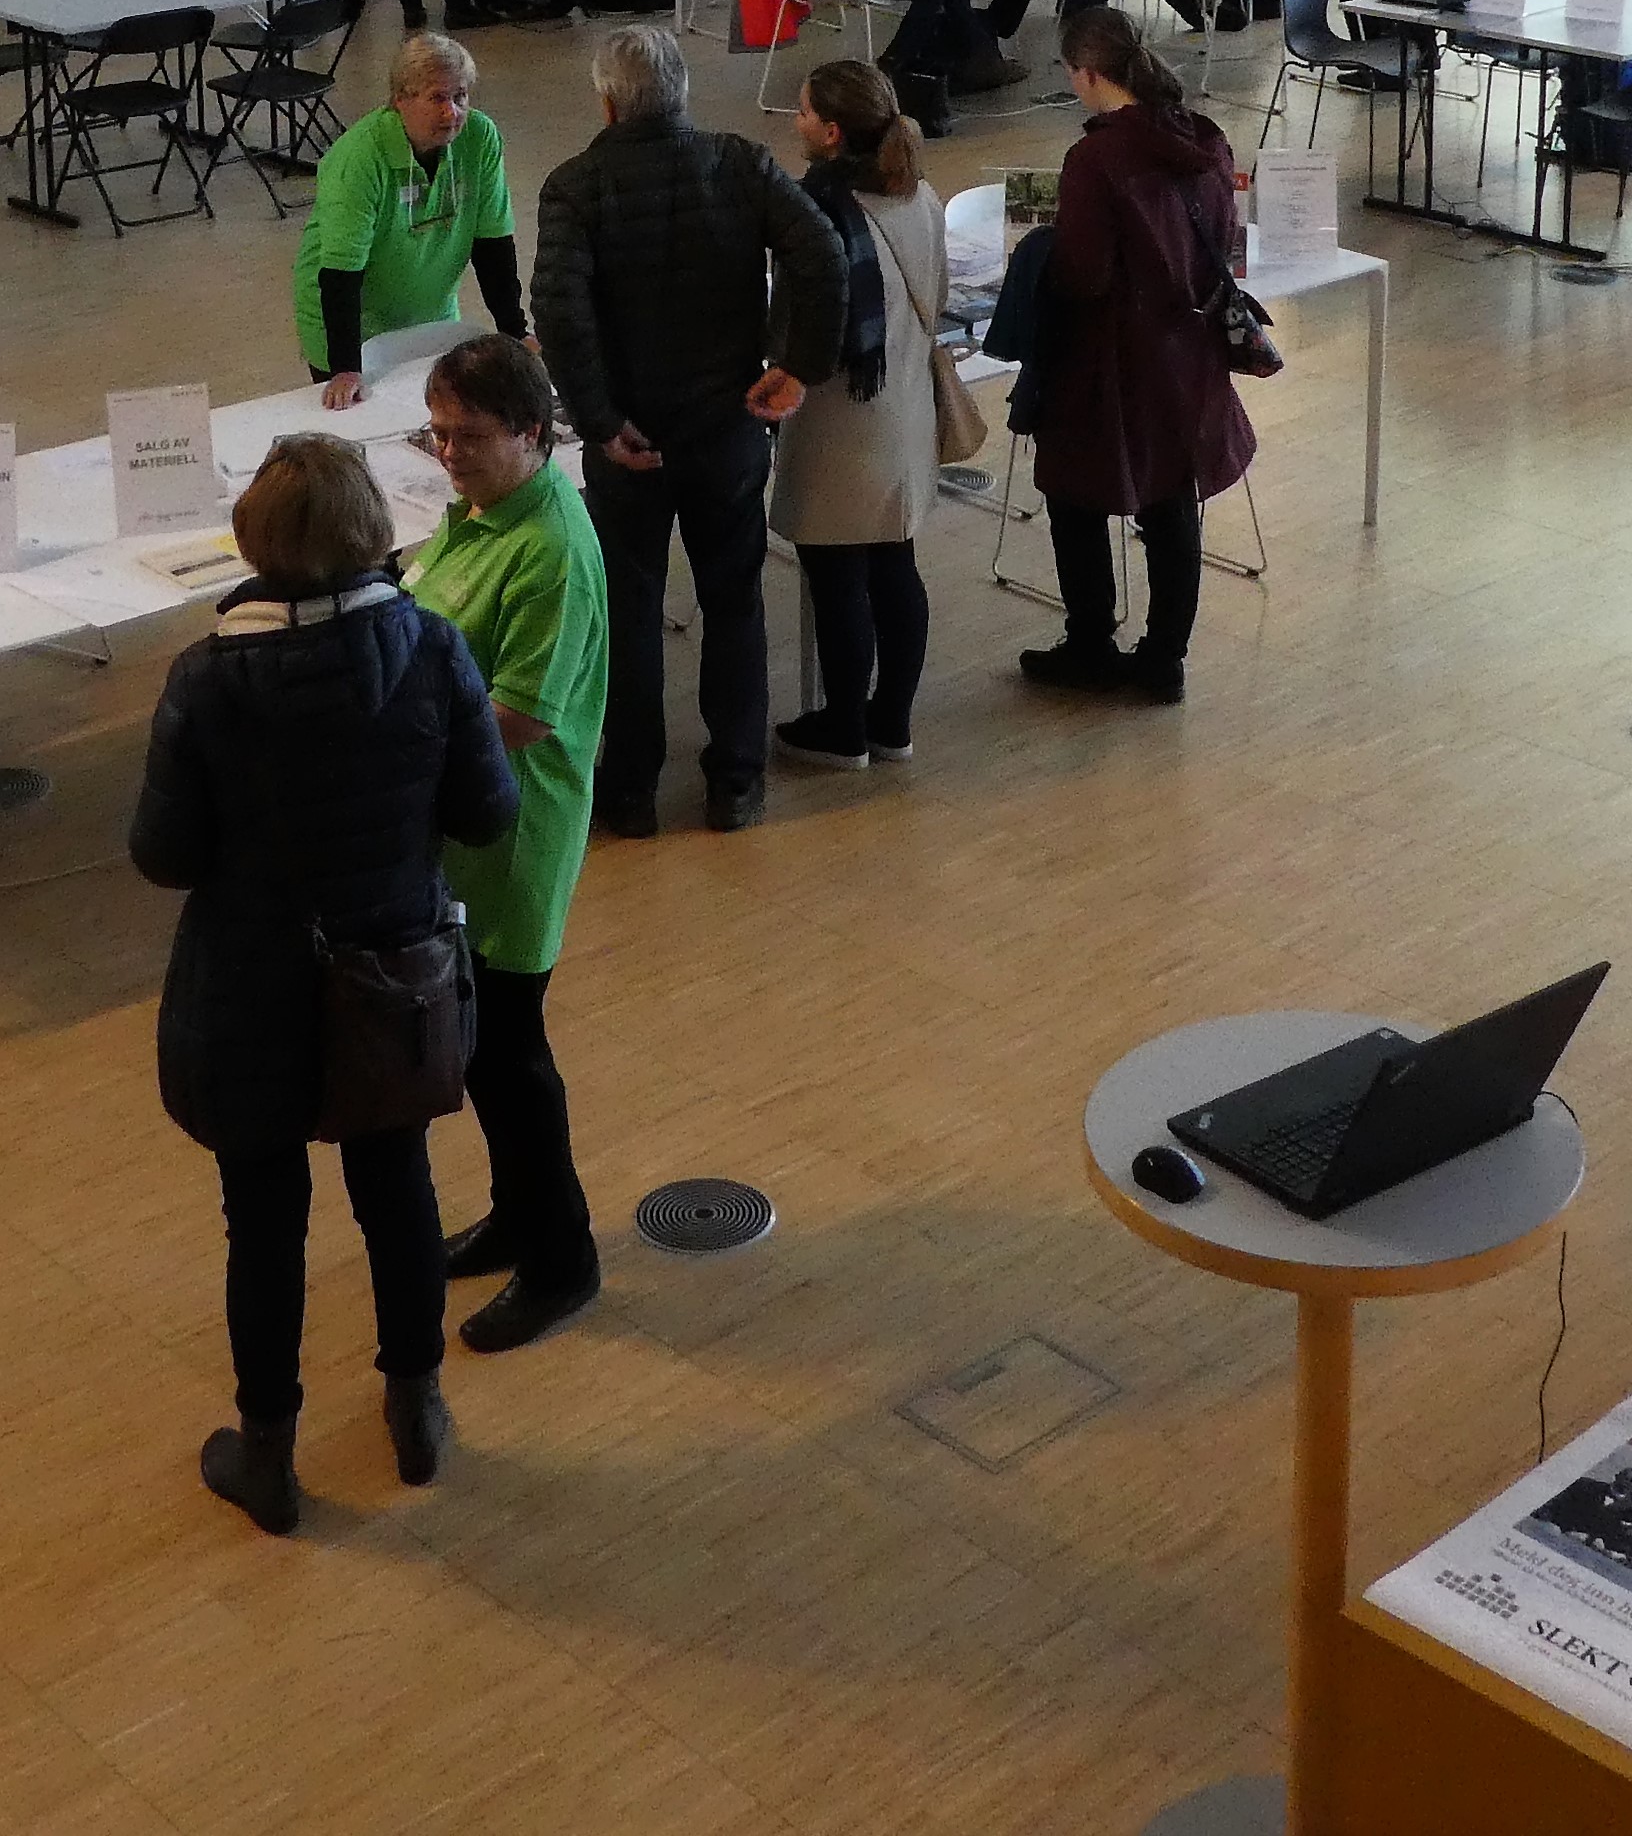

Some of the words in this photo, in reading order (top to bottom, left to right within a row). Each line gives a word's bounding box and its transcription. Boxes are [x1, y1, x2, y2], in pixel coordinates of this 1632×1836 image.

[129, 454, 199, 470] MATERIELL
[136, 439, 170, 453] SALG
[173, 436, 190, 447] AV
[1497, 1537, 1550, 1566] Meld
[1585, 1584, 1617, 1608] inn
[1528, 1619, 1629, 1677] SLEKT
